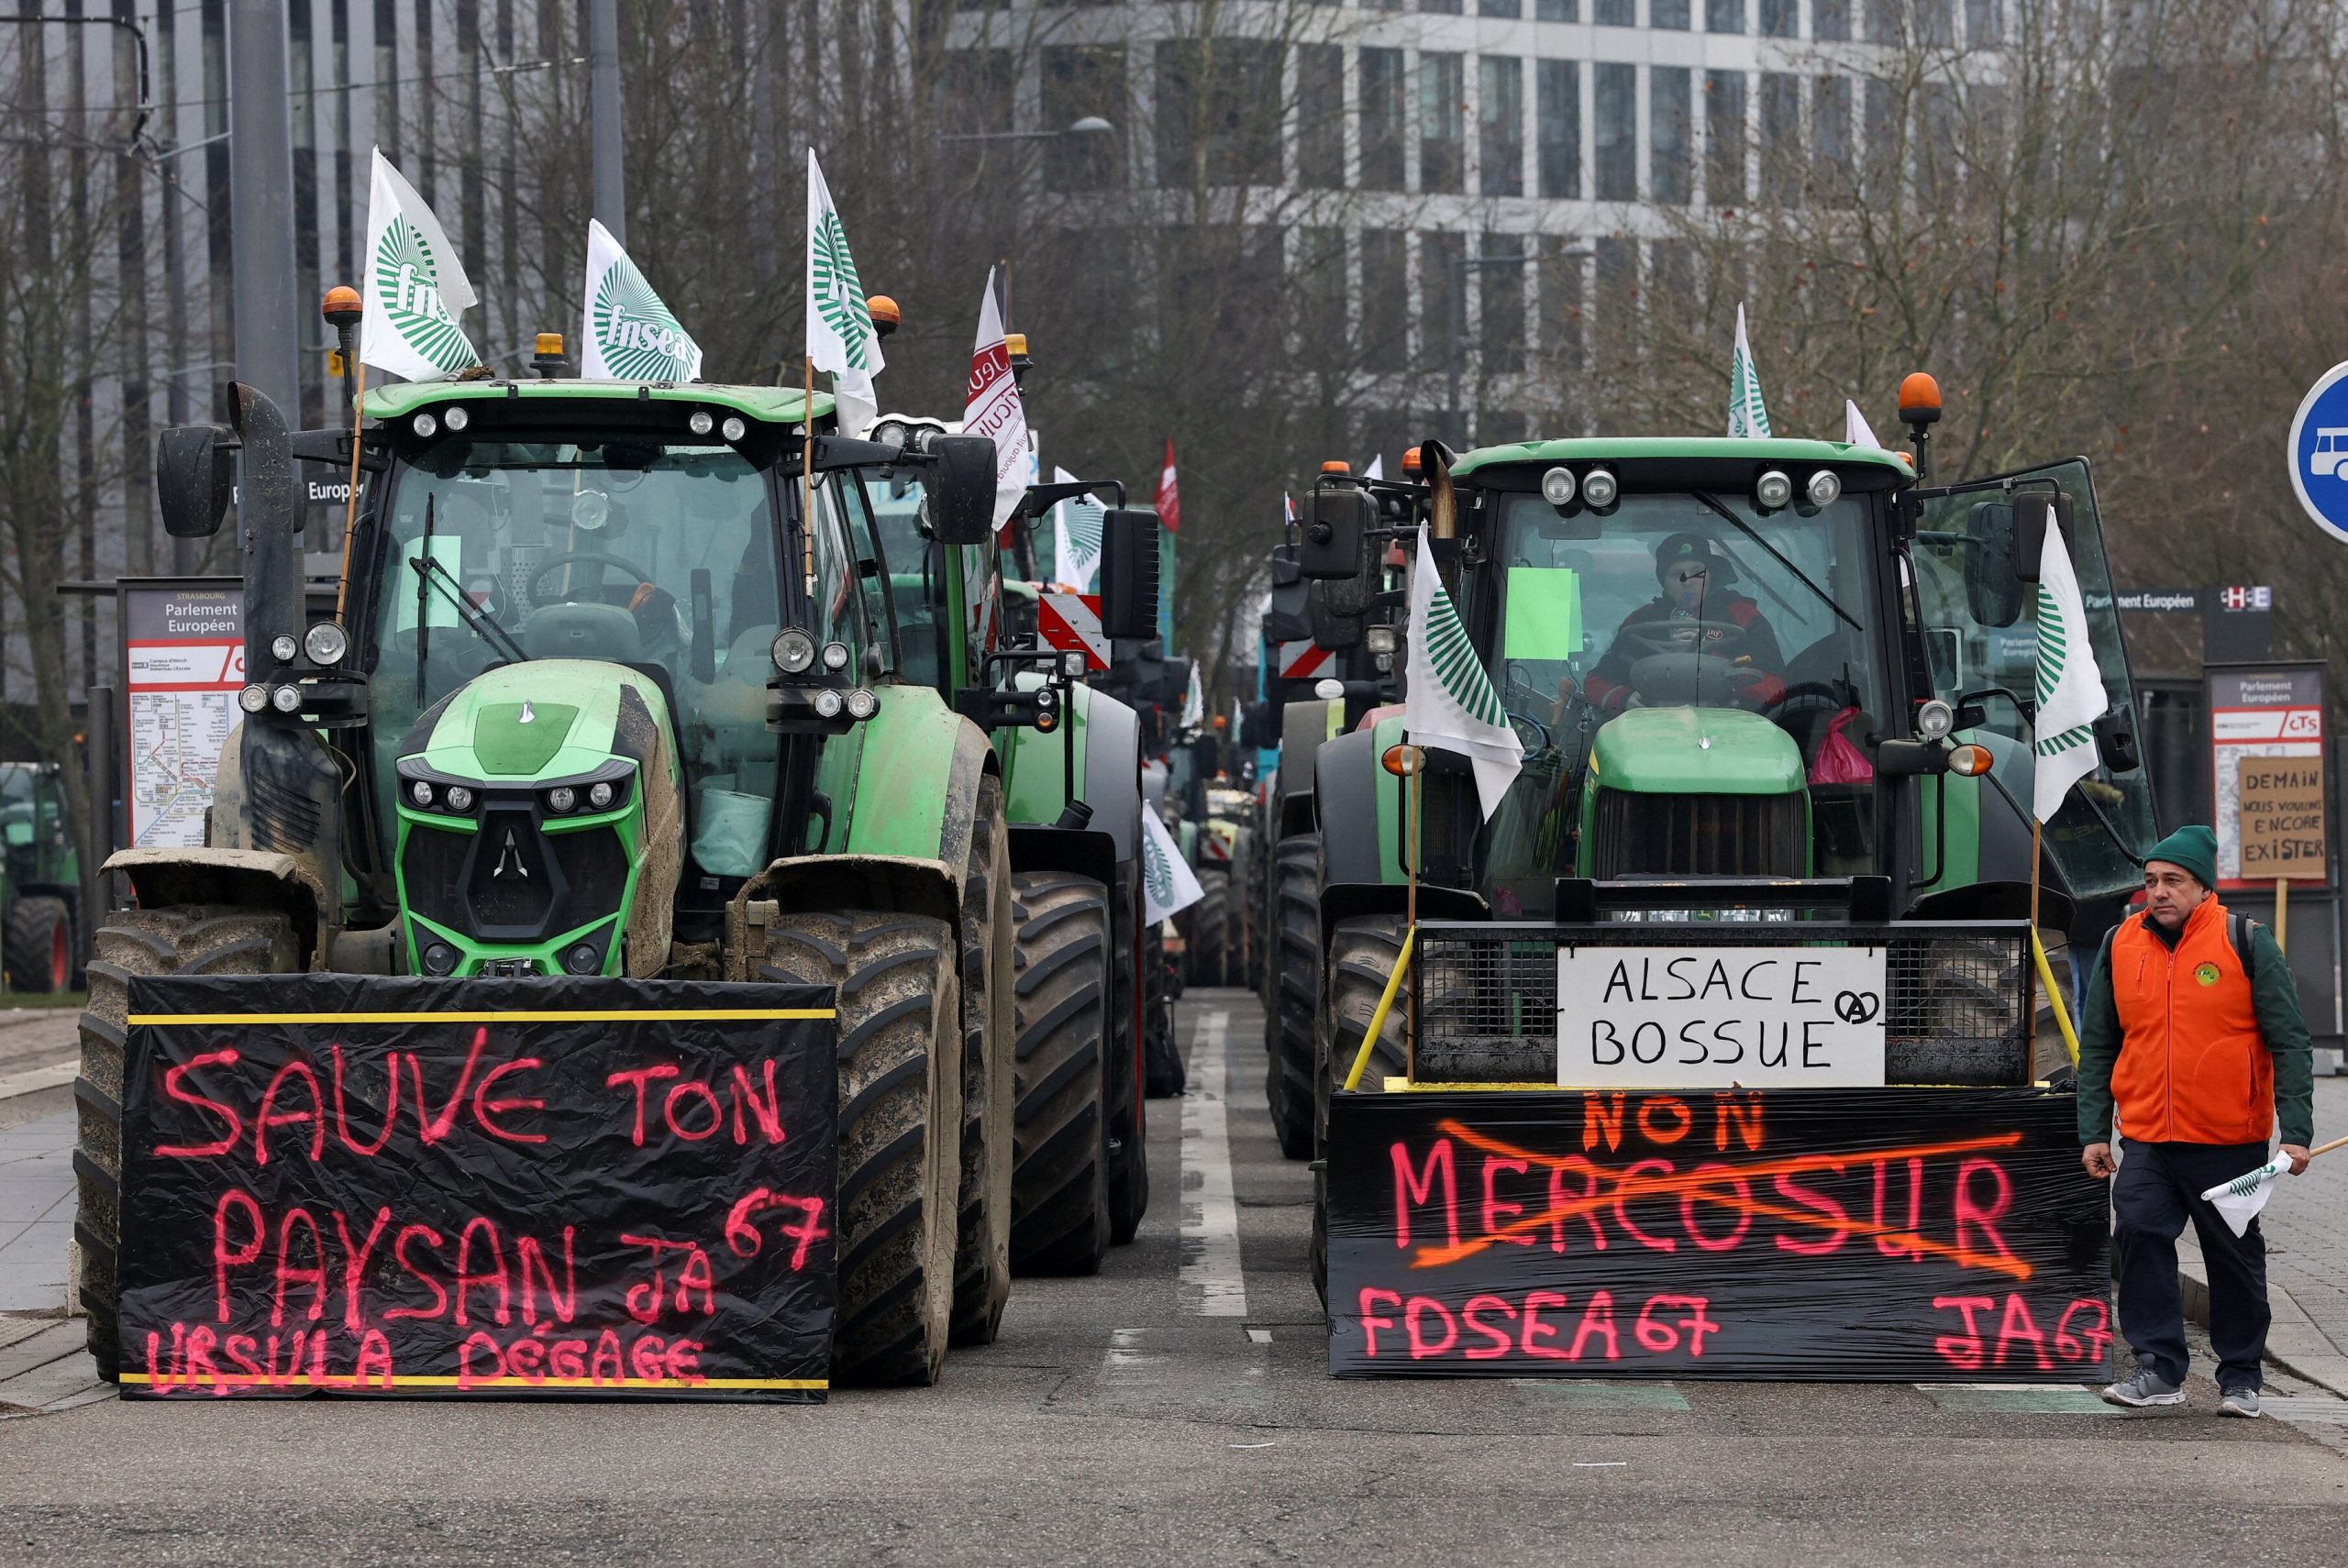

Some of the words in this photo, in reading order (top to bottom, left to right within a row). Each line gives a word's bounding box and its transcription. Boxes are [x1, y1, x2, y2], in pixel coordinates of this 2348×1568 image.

[605, 304, 687, 363] fnsea
[176, 592, 226, 601] STRASBOURG
[2143, 593, 2194, 612] Européen
[165, 602, 238, 616] Parlement
[168, 618, 236, 635] Européen
[2240, 681, 2292, 691] Parlement
[2242, 692, 2291, 703] Européen
[2289, 716, 2317, 731] CTS
[2243, 800, 2274, 812] NOUS
[2278, 799, 2322, 812] VOULONS
[2254, 815, 2320, 834] ENCORE
[1602, 956, 1822, 1004] ALSACE
[1591, 1020, 1833, 1068] BOSSUE
[154, 1026, 548, 1165] SAUVE
[607, 1059, 786, 1145] TON
[1582, 1091, 1763, 1153] NON
[1390, 1137, 2013, 1267] MERCOSUR
[214, 1188, 575, 1330] PAYSAN
[620, 1233, 715, 1323] JA
[725, 1187, 827, 1272] 67
[147, 1322, 393, 1396] URSULA
